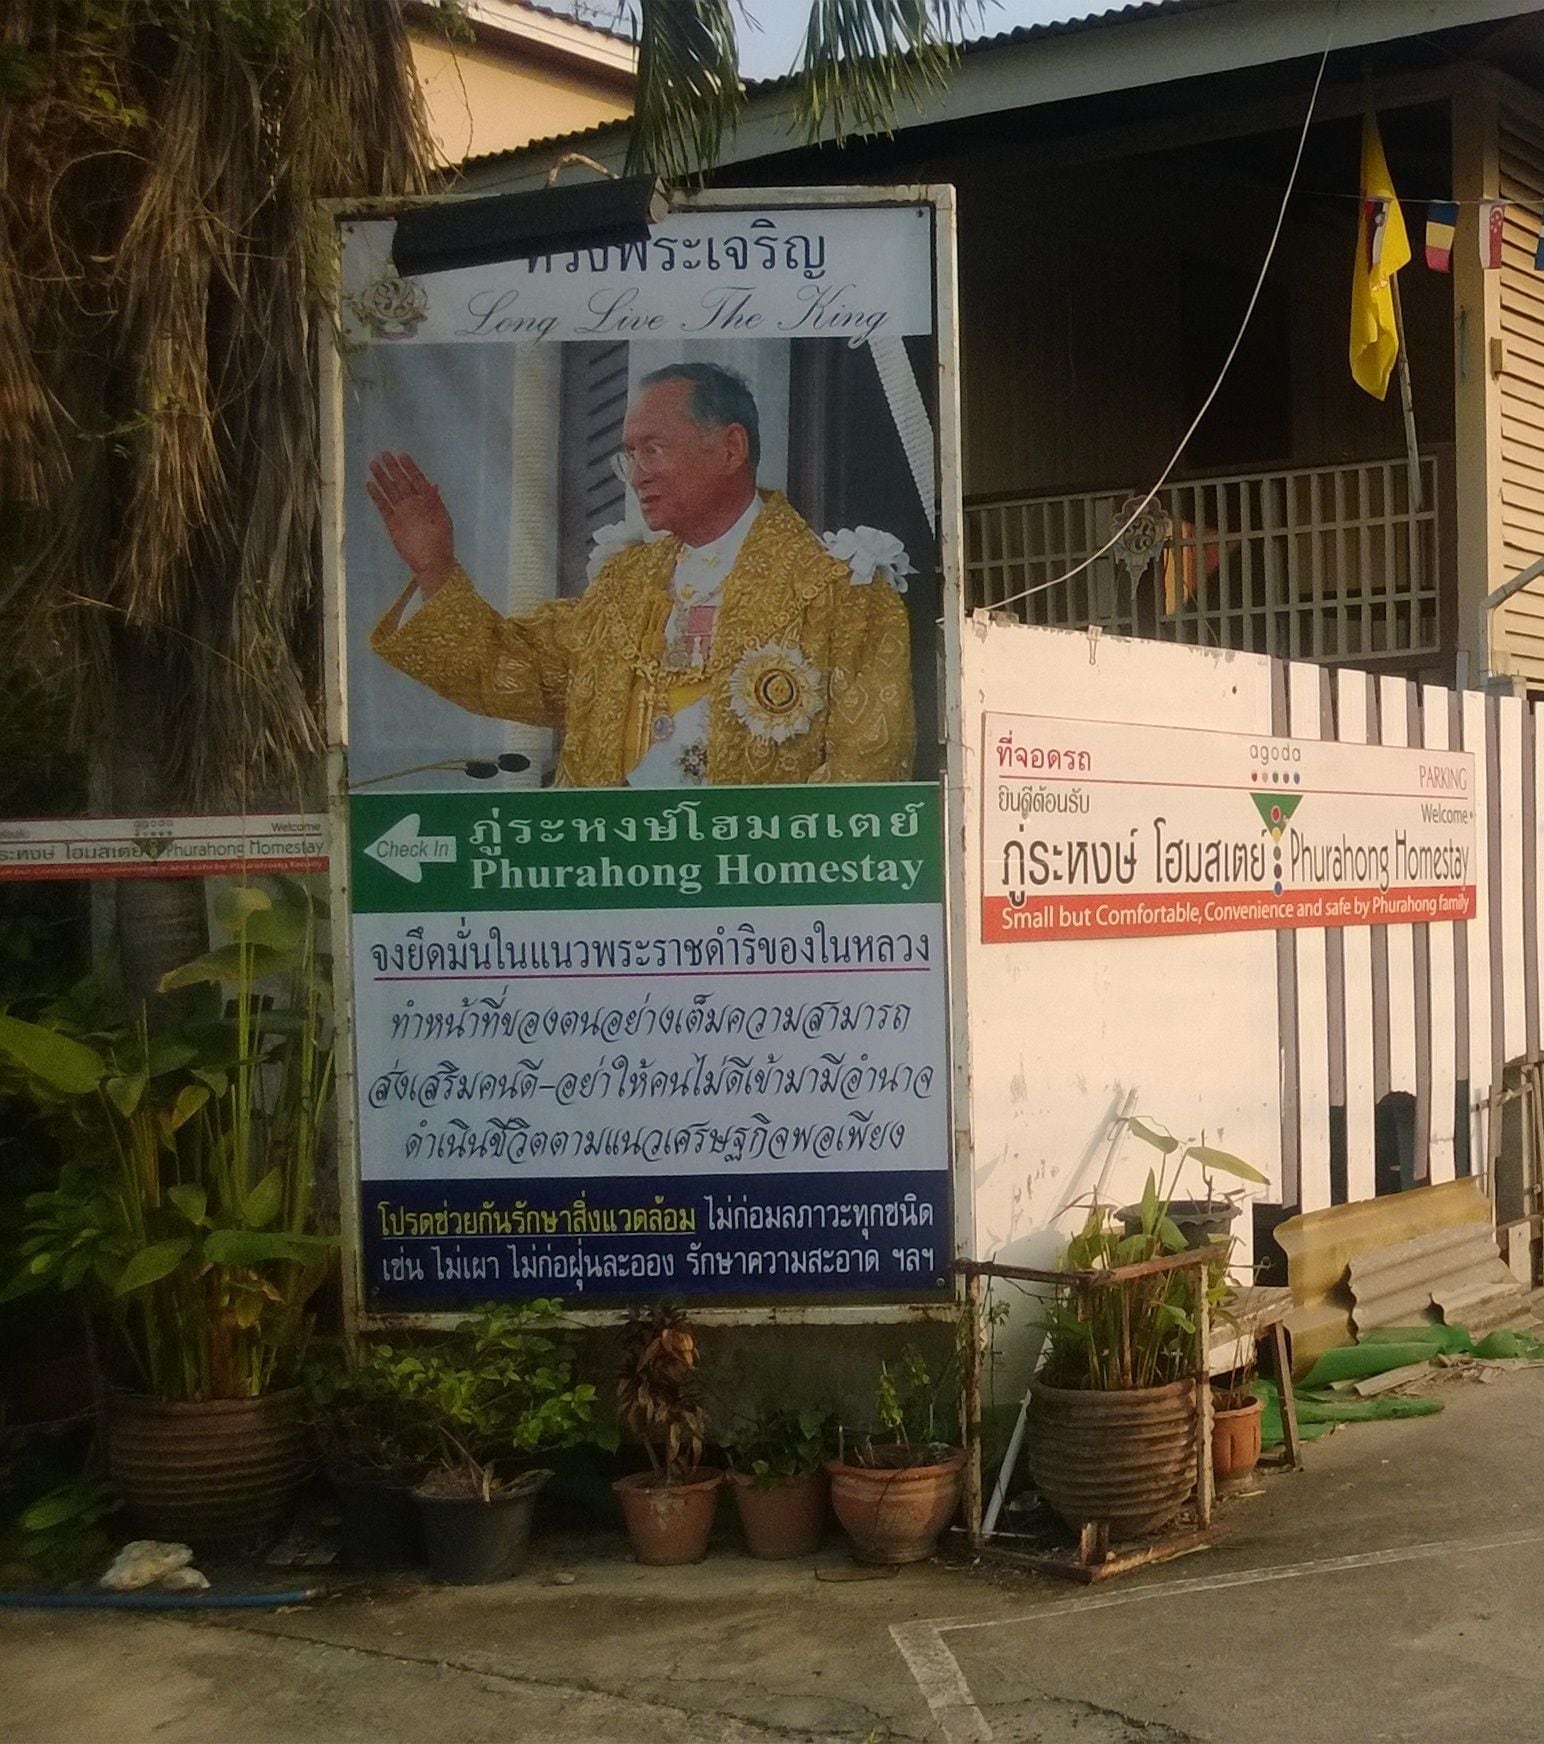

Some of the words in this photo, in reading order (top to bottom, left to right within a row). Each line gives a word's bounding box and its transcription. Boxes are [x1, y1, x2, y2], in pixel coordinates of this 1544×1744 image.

[454, 289, 559, 348] Long
[573, 287, 665, 334] Live
[681, 286, 765, 332] The
[777, 284, 888, 349] King
[997, 730, 1091, 771] ที่จอดรถ
[1250, 744, 1301, 765] agoda
[1419, 765, 1468, 791] PARKING
[998, 784, 1091, 815] ยินดีต้อนรับ
[1421, 804, 1469, 825] Welcome
[271, 821, 322, 833] Welcome
[250, 840, 325, 857] Homestay
[376, 840, 428, 858] Check
[433, 840, 449, 857] In
[1153, 816, 1267, 883] โฮมสเตย์
[1290, 827, 1390, 892] Phurahong
[1395, 829, 1469, 890] Homestay
[469, 856, 702, 894] Phurahong
[715, 853, 925, 890] Homestay
[1002, 906, 1053, 929] Small
[1059, 904, 1091, 927] but
[1096, 902, 1202, 926] Comfortable,
[1204, 900, 1294, 922] Convenience
[1296, 899, 1322, 918] and
[1325, 897, 1351, 916] safe
[1354, 896, 1369, 919] by
[1372, 894, 1438, 915] Phurahong
[1438, 893, 1469, 914] family
[370, 916, 931, 972] จงยึดมั่นในแนวพระราชดำริของในหลวง
[390, 985, 911, 1043] ทำหน้าที่ของตนอย่างเต็มความสามารถ
[405, 1110, 906, 1164] ดำเนินชีวิตตามแนวเศรษฐกิจพอเพียง
[377, 1190, 696, 1236] โปรดช่วยกันรักษาสิ่งแวดล้อม
[704, 1193, 934, 1241] ไม่ก่อมลภาวะทุกชนิด
[382, 1246, 424, 1281] เช่น
[431, 1245, 500, 1280] ไม่เผา
[507, 1238, 675, 1291] ไม่ก่อฝุ่นละออง
[686, 1242, 880, 1276] รักษาความสะอาด
